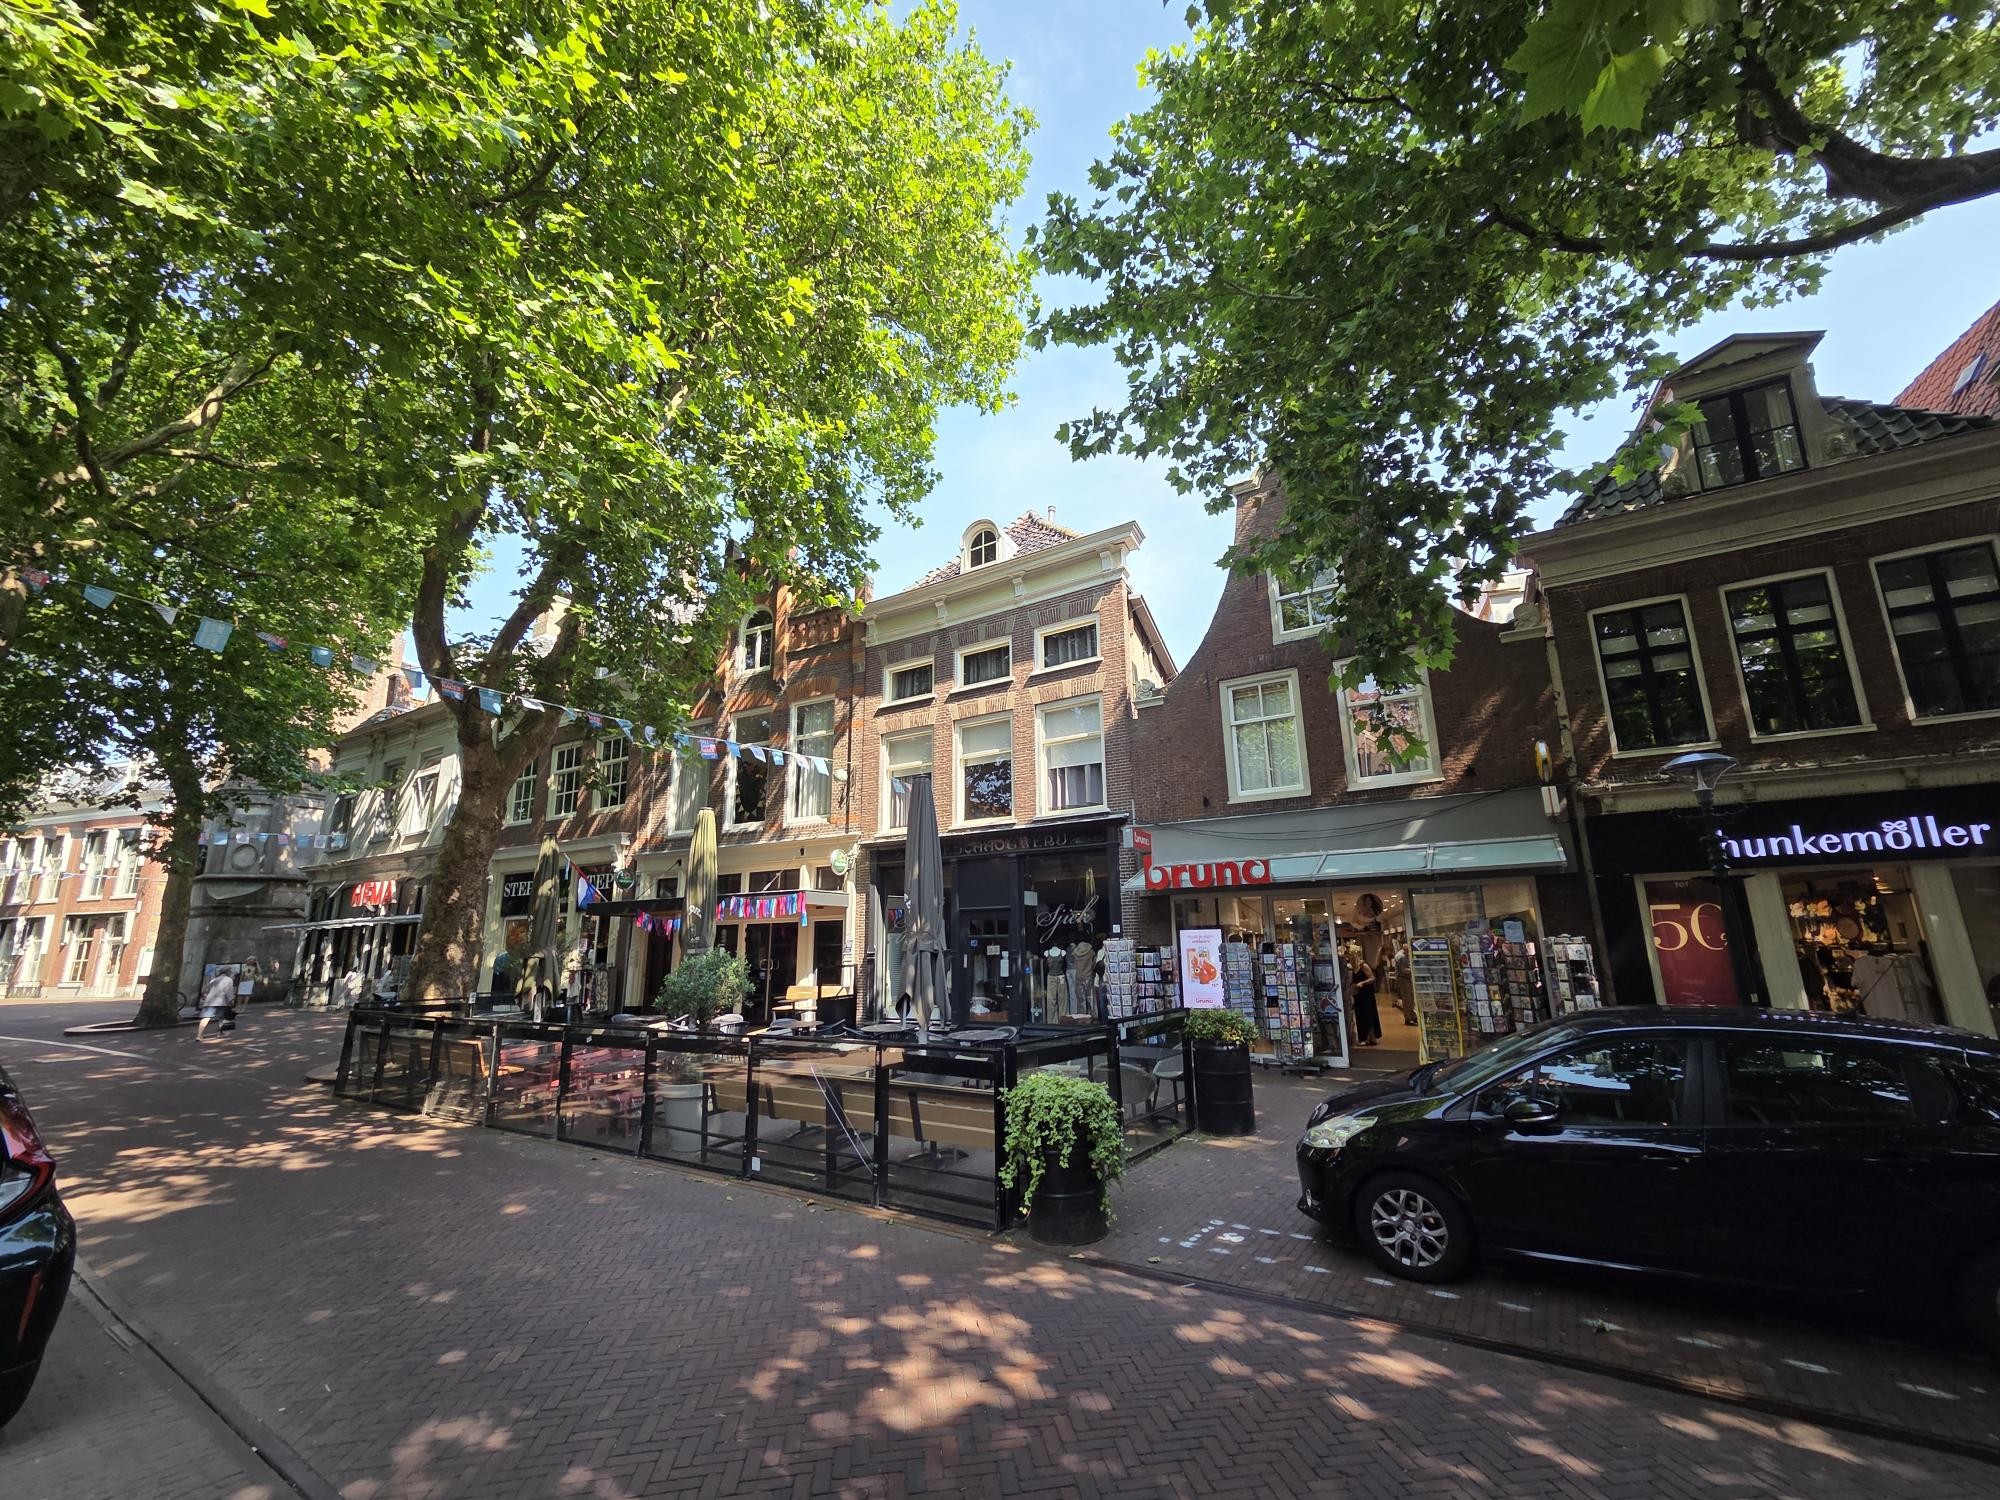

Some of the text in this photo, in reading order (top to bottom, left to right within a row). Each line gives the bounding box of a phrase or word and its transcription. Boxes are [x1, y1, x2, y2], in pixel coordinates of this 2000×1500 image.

[1134, 832, 1150, 846] bruna
[1143, 855, 1271, 890] bruna
[352, 880, 397, 907] HEMA
